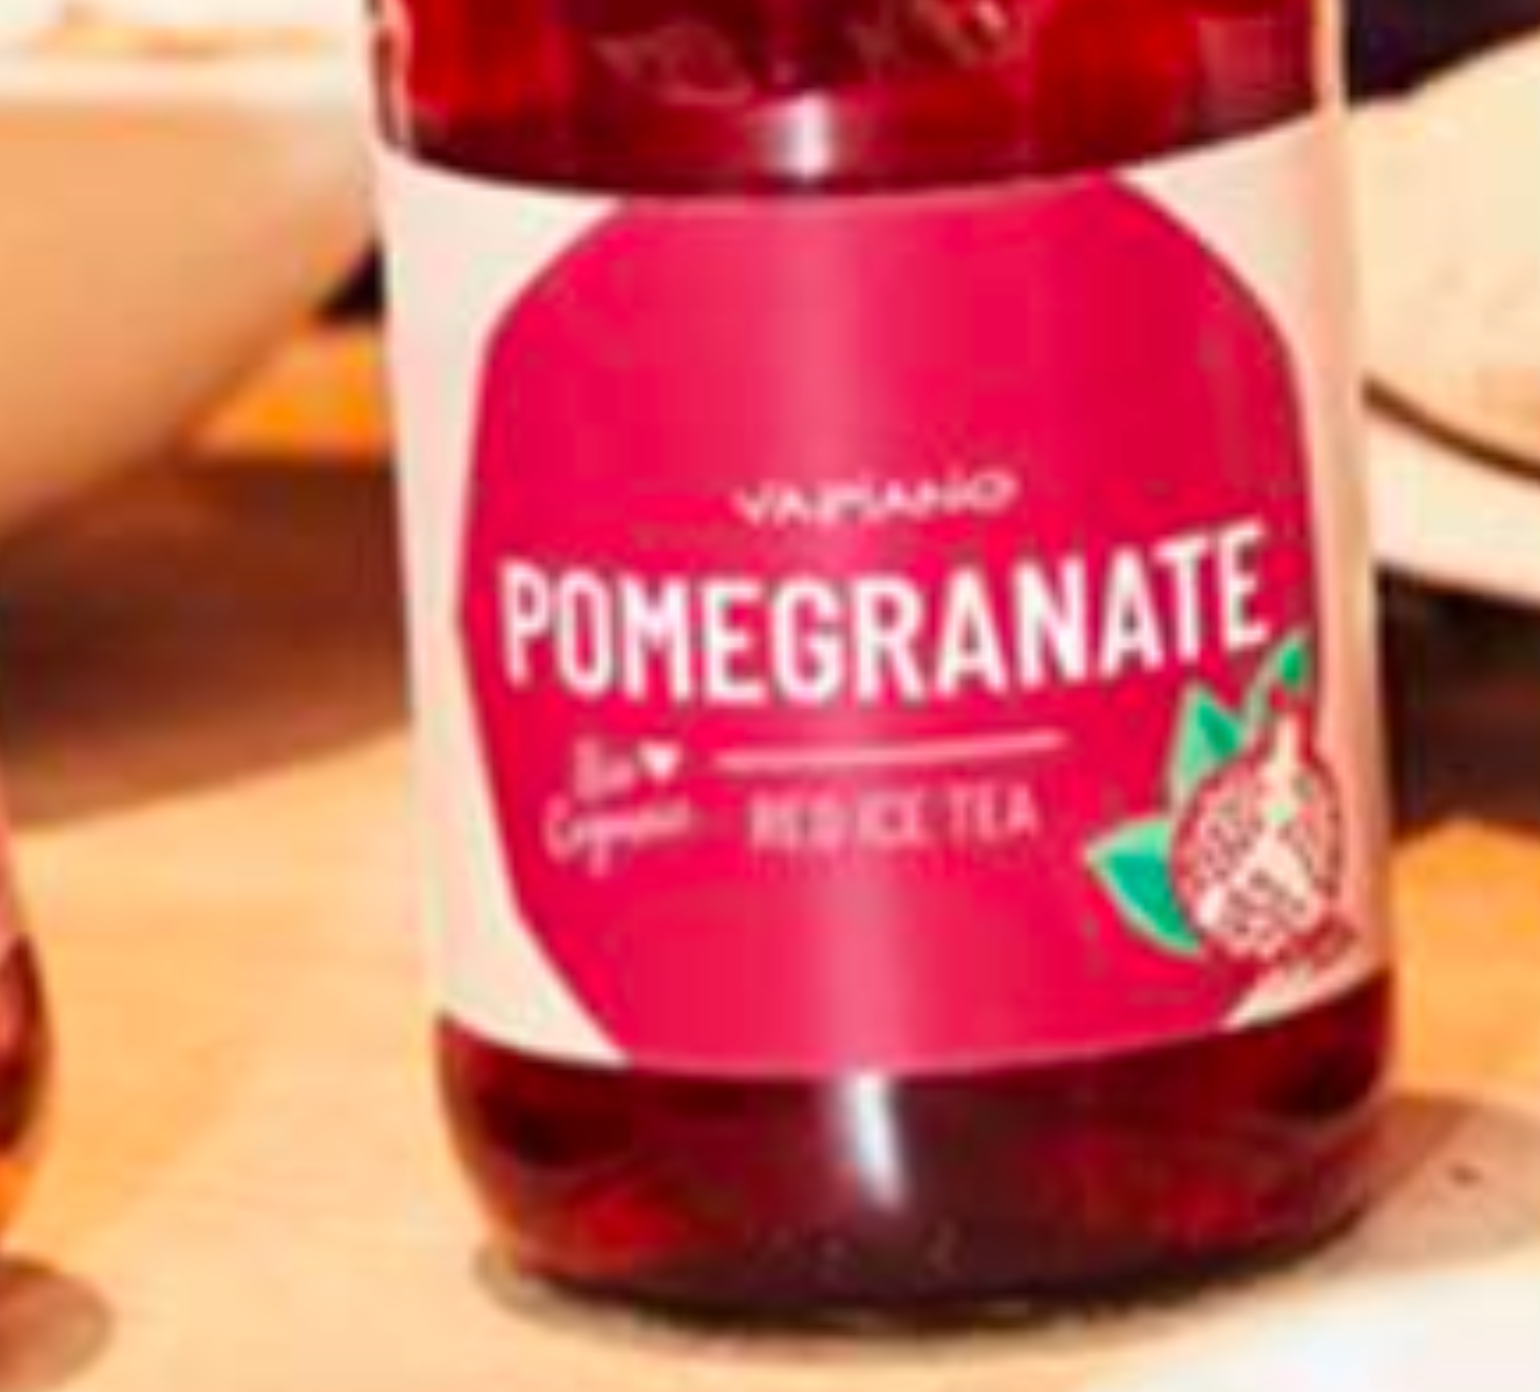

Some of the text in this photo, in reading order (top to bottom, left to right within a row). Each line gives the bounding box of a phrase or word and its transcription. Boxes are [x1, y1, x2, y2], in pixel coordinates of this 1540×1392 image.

[732, 468, 1018, 527] VAPIANO
[500, 517, 1270, 707] POMEGRANATE
[745, 779, 1042, 852] RED ICE TEA
